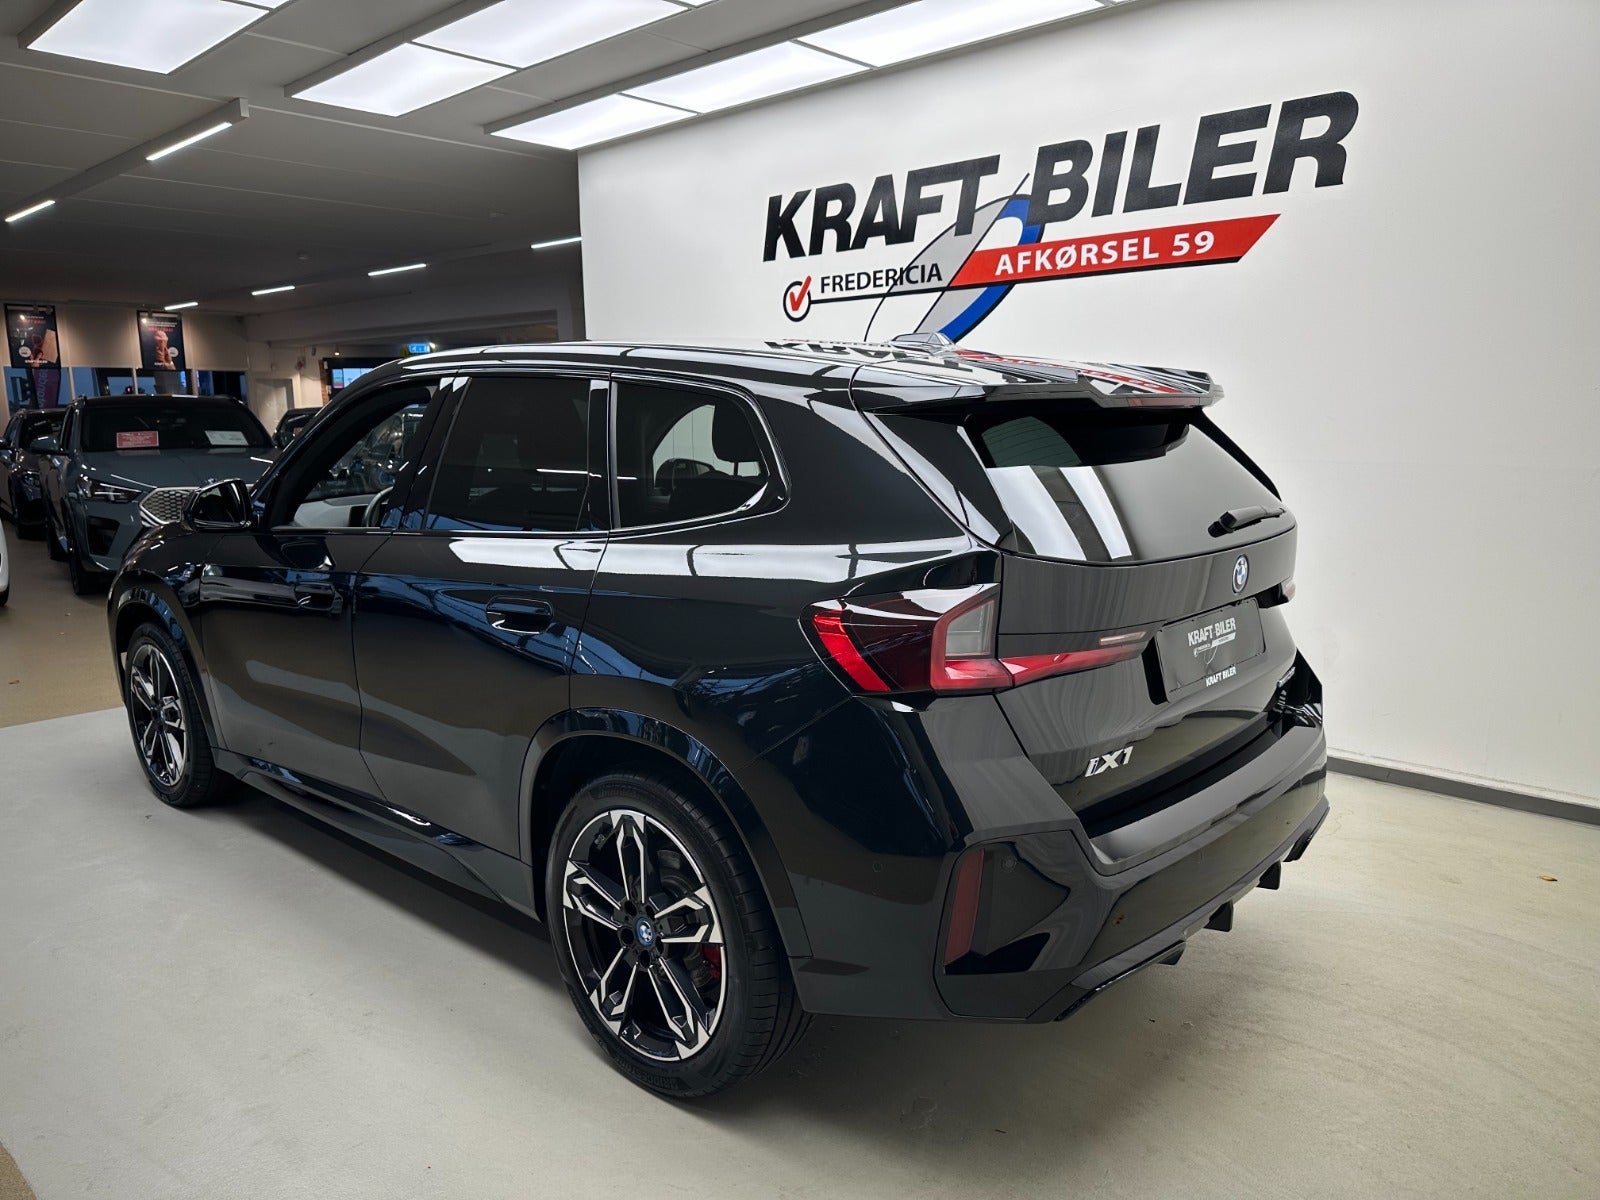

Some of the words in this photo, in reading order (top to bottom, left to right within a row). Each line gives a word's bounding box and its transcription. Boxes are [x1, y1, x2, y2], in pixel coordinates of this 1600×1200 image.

[763, 154, 1001, 262] KRAFT
[1026, 91, 1359, 226] BILER
[994, 237, 1160, 276] AFKØRSEL
[1171, 229, 1216, 258] 59
[820, 262, 943, 295] FREDERICIA
[1187, 625, 1213, 646] KRAFT
[1214, 617, 1236, 637] BILER
[1205, 673, 1222, 687] KRAFT
[1222, 666, 1237, 680] BILER
[1085, 746, 1134, 778] iX1
